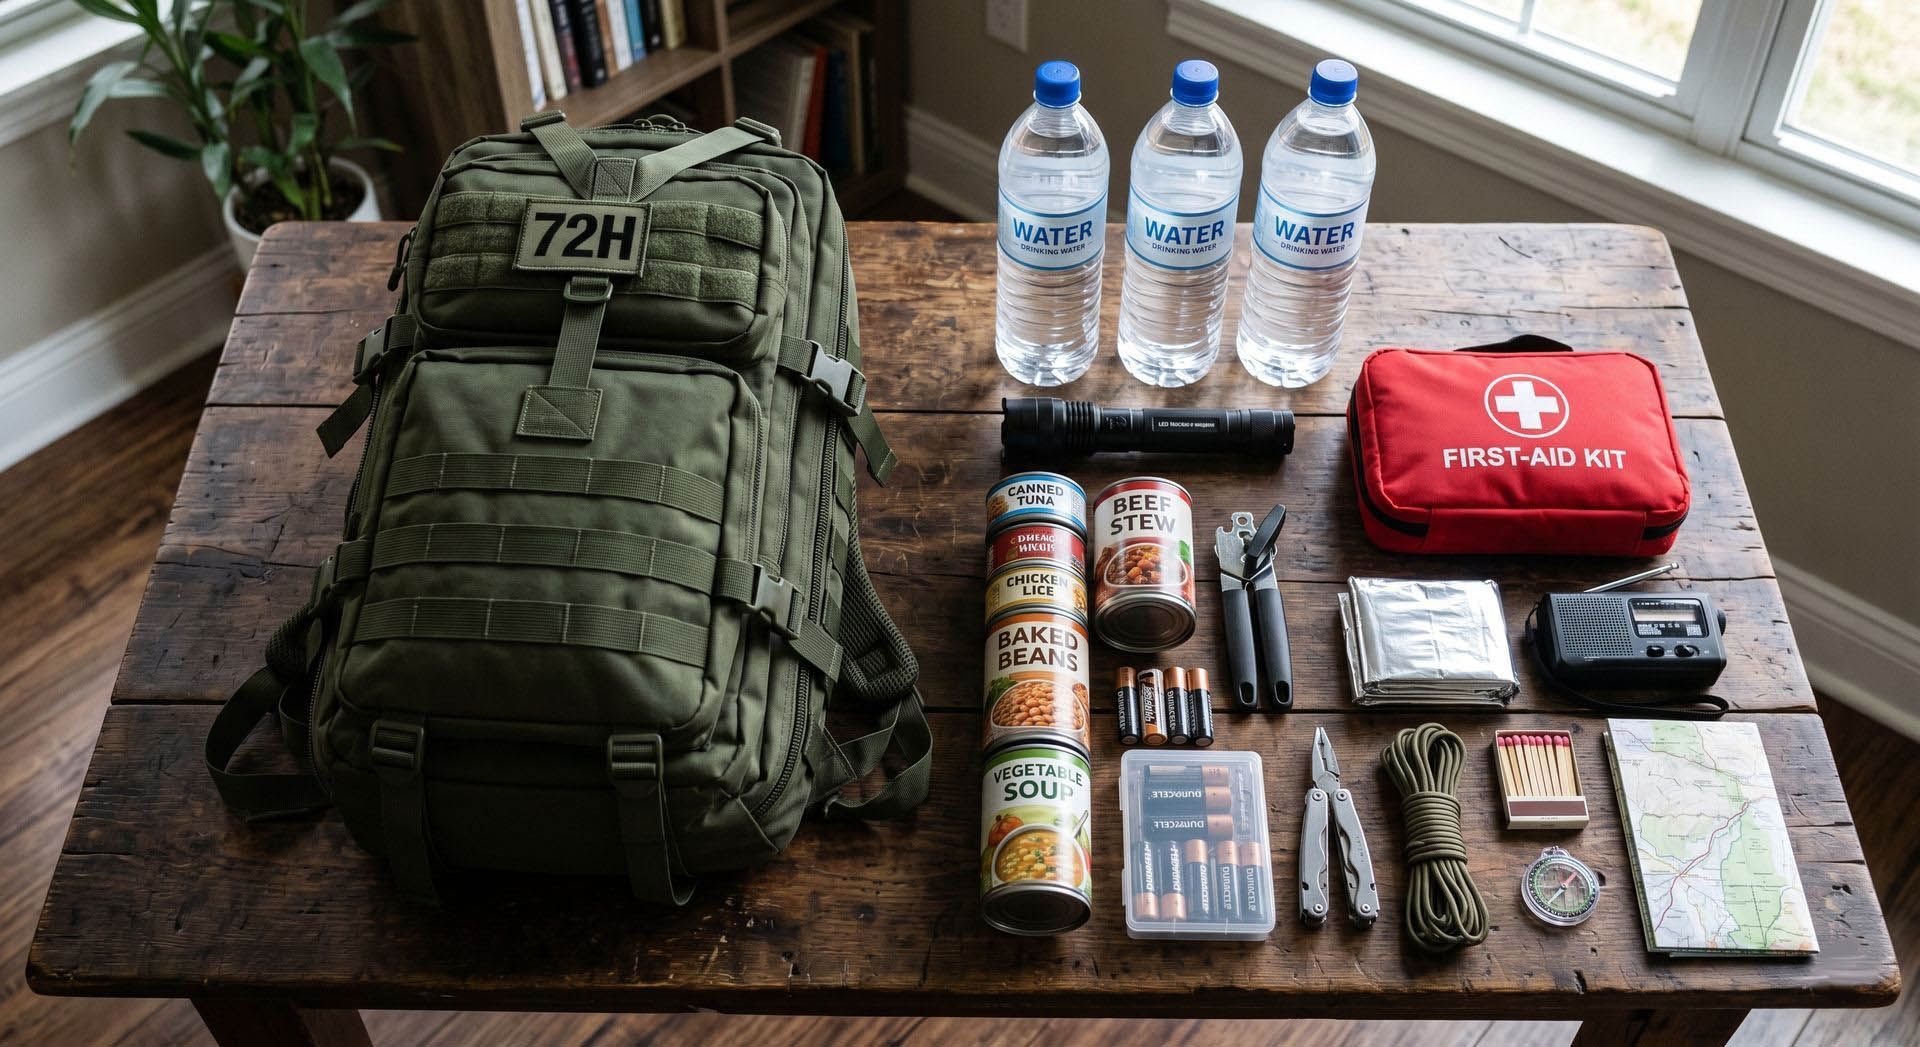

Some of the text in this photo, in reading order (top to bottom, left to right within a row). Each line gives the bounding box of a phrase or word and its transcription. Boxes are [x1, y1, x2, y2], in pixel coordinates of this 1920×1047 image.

[534, 212, 637, 260] 72H
[1013, 216, 1093, 245] WATER
[1144, 216, 1225, 245] WATER
[1274, 215, 1355, 245] WATER
[1020, 242, 1086, 255] DRINKING WATER
[1151, 242, 1217, 255] DRINKING WATER
[1280, 242, 1346, 255] DRINKING WATER
[1442, 446, 1627, 469] FIRST-AID KIT
[1008, 483, 1064, 497] CANNED
[1017, 495, 1055, 506] TUNA
[1113, 494, 1172, 515] BEEF
[1110, 513, 1176, 536] STEW
[1006, 573, 1069, 588] CHICKEN
[1023, 585, 1054, 596] LICE
[998, 626, 1079, 651] BAKED
[998, 647, 1078, 672] BEANS
[994, 763, 1083, 788] VEGETABLE
[1004, 779, 1074, 801] SOUP
